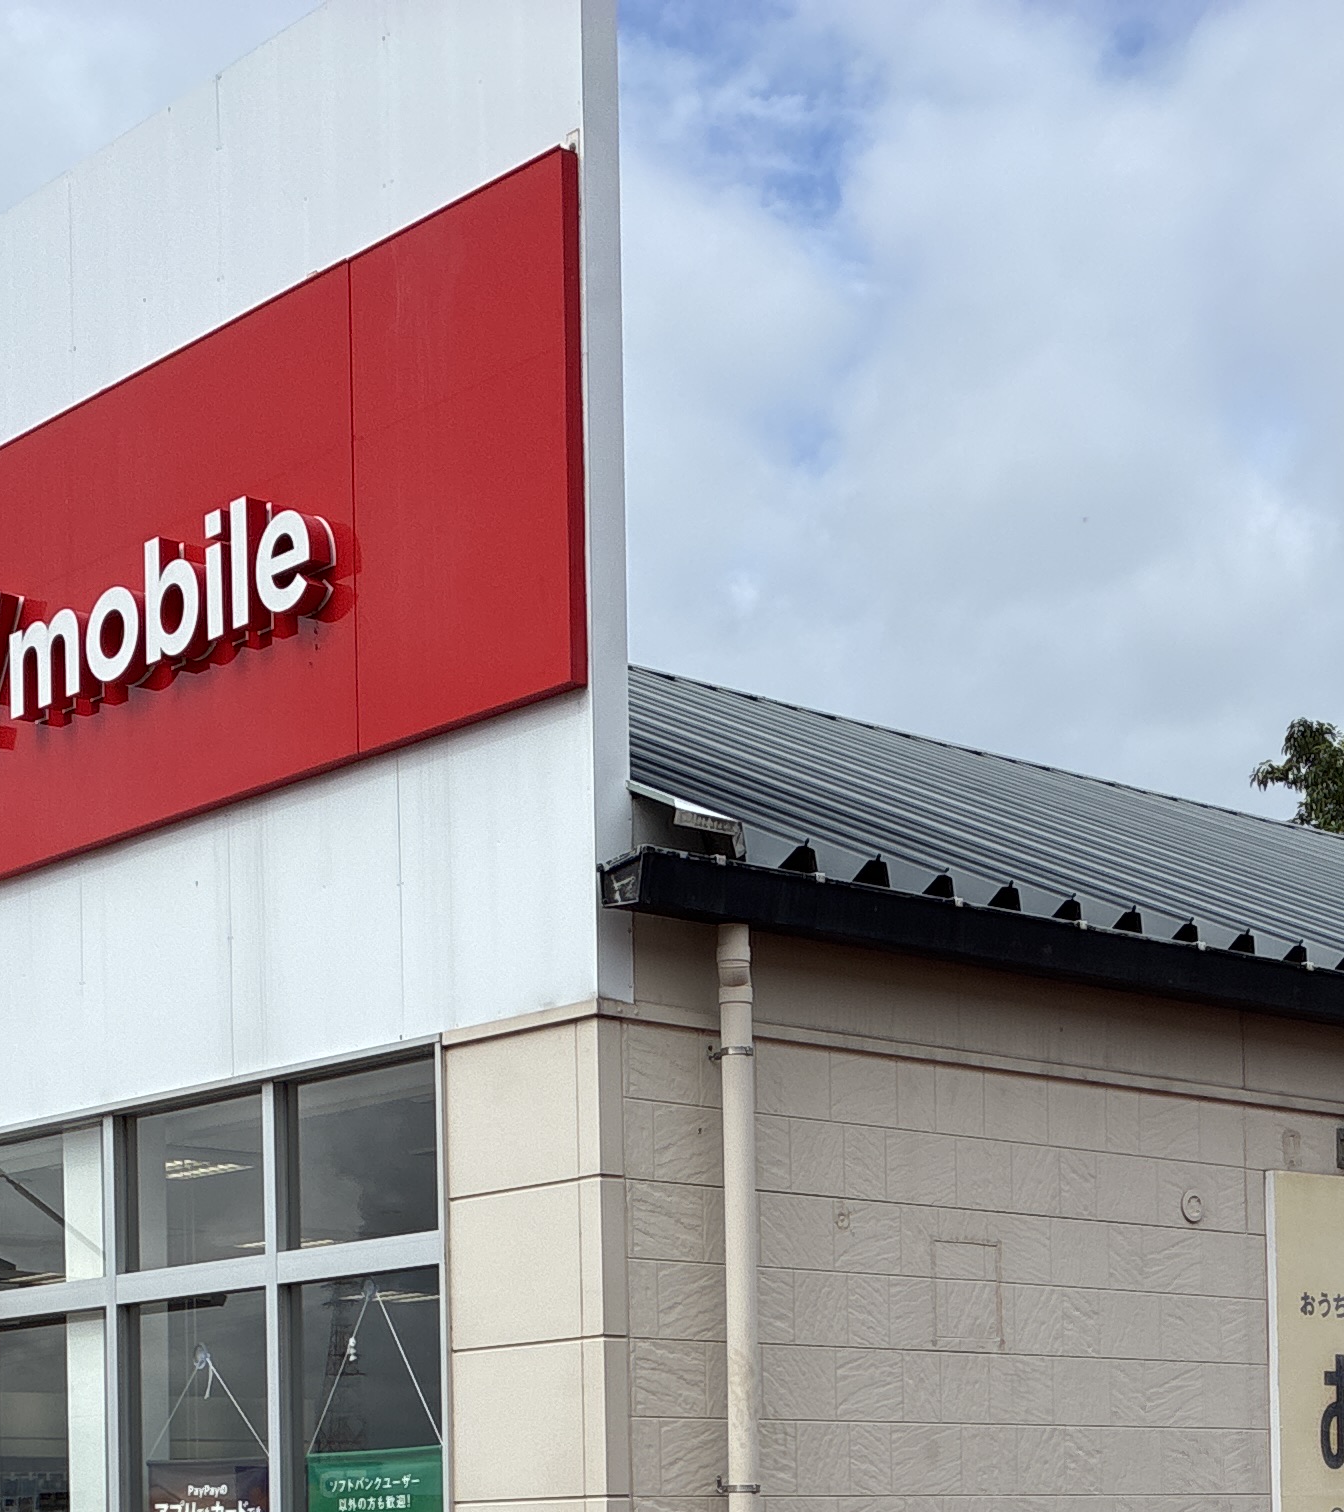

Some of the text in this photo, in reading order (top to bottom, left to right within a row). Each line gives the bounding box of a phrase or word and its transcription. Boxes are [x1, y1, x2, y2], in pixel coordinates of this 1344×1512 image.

[329, 1473, 421, 1493] ソフトバンクユーザー
[338, 1493, 412, 1512] 以外の方も歓迎!
